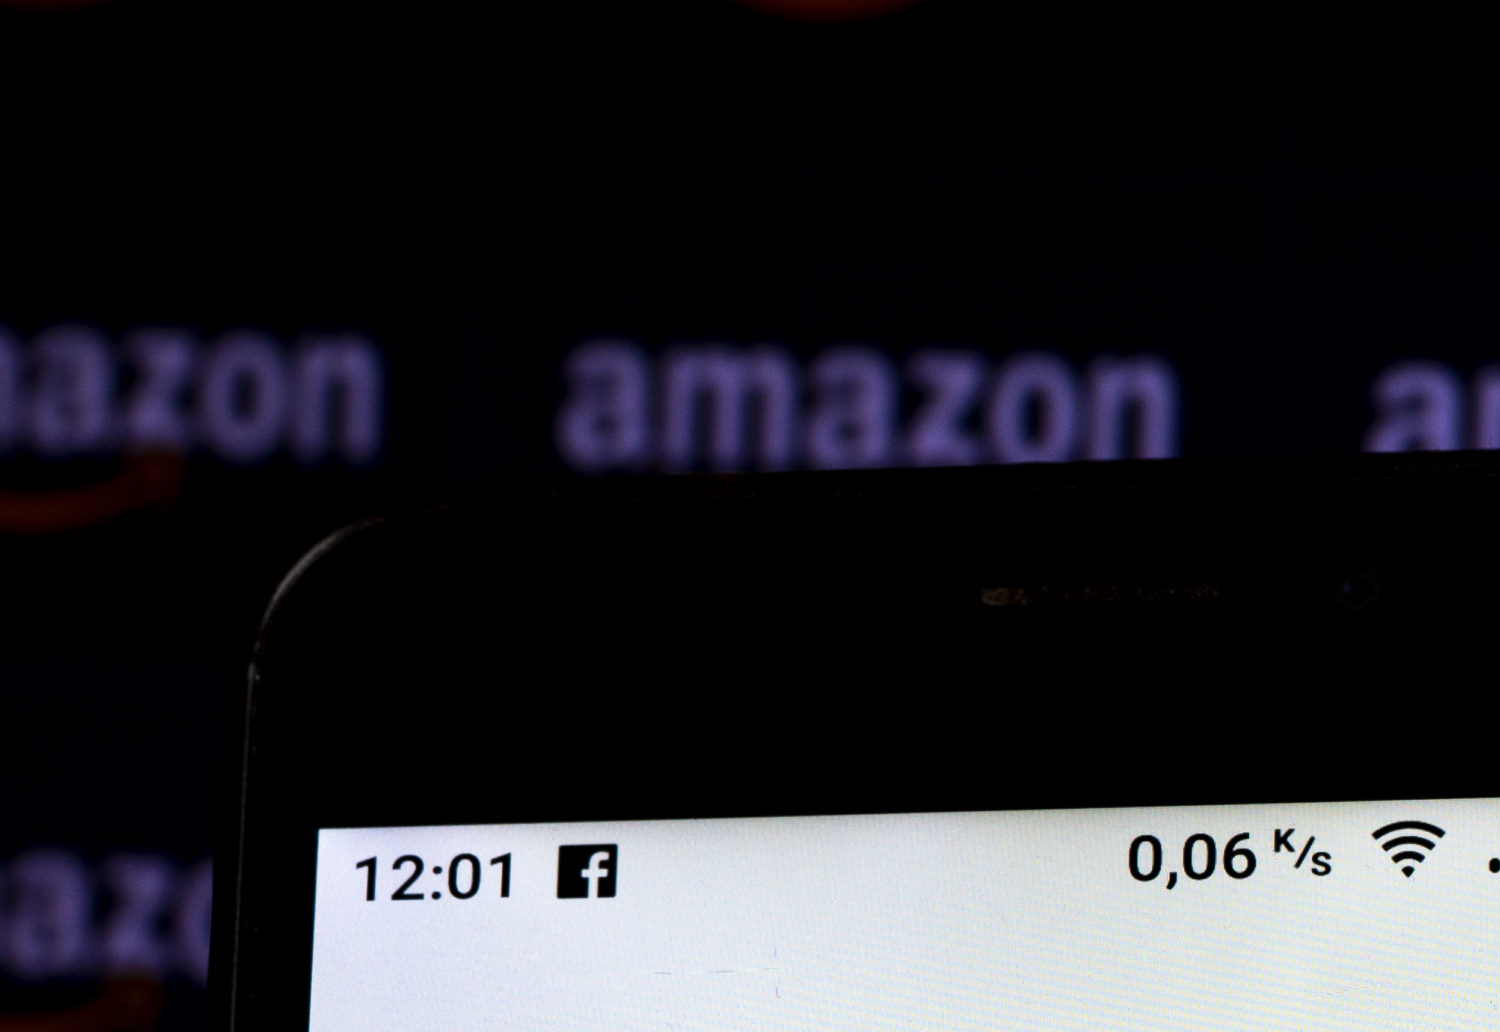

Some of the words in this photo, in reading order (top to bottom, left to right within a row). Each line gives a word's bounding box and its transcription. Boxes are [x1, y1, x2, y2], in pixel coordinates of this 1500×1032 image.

[0, 332, 384, 457] azon
[560, 342, 1180, 472] amazon
[356, 852, 512, 902] 12:01
[1128, 832, 1257, 890] 0,06
